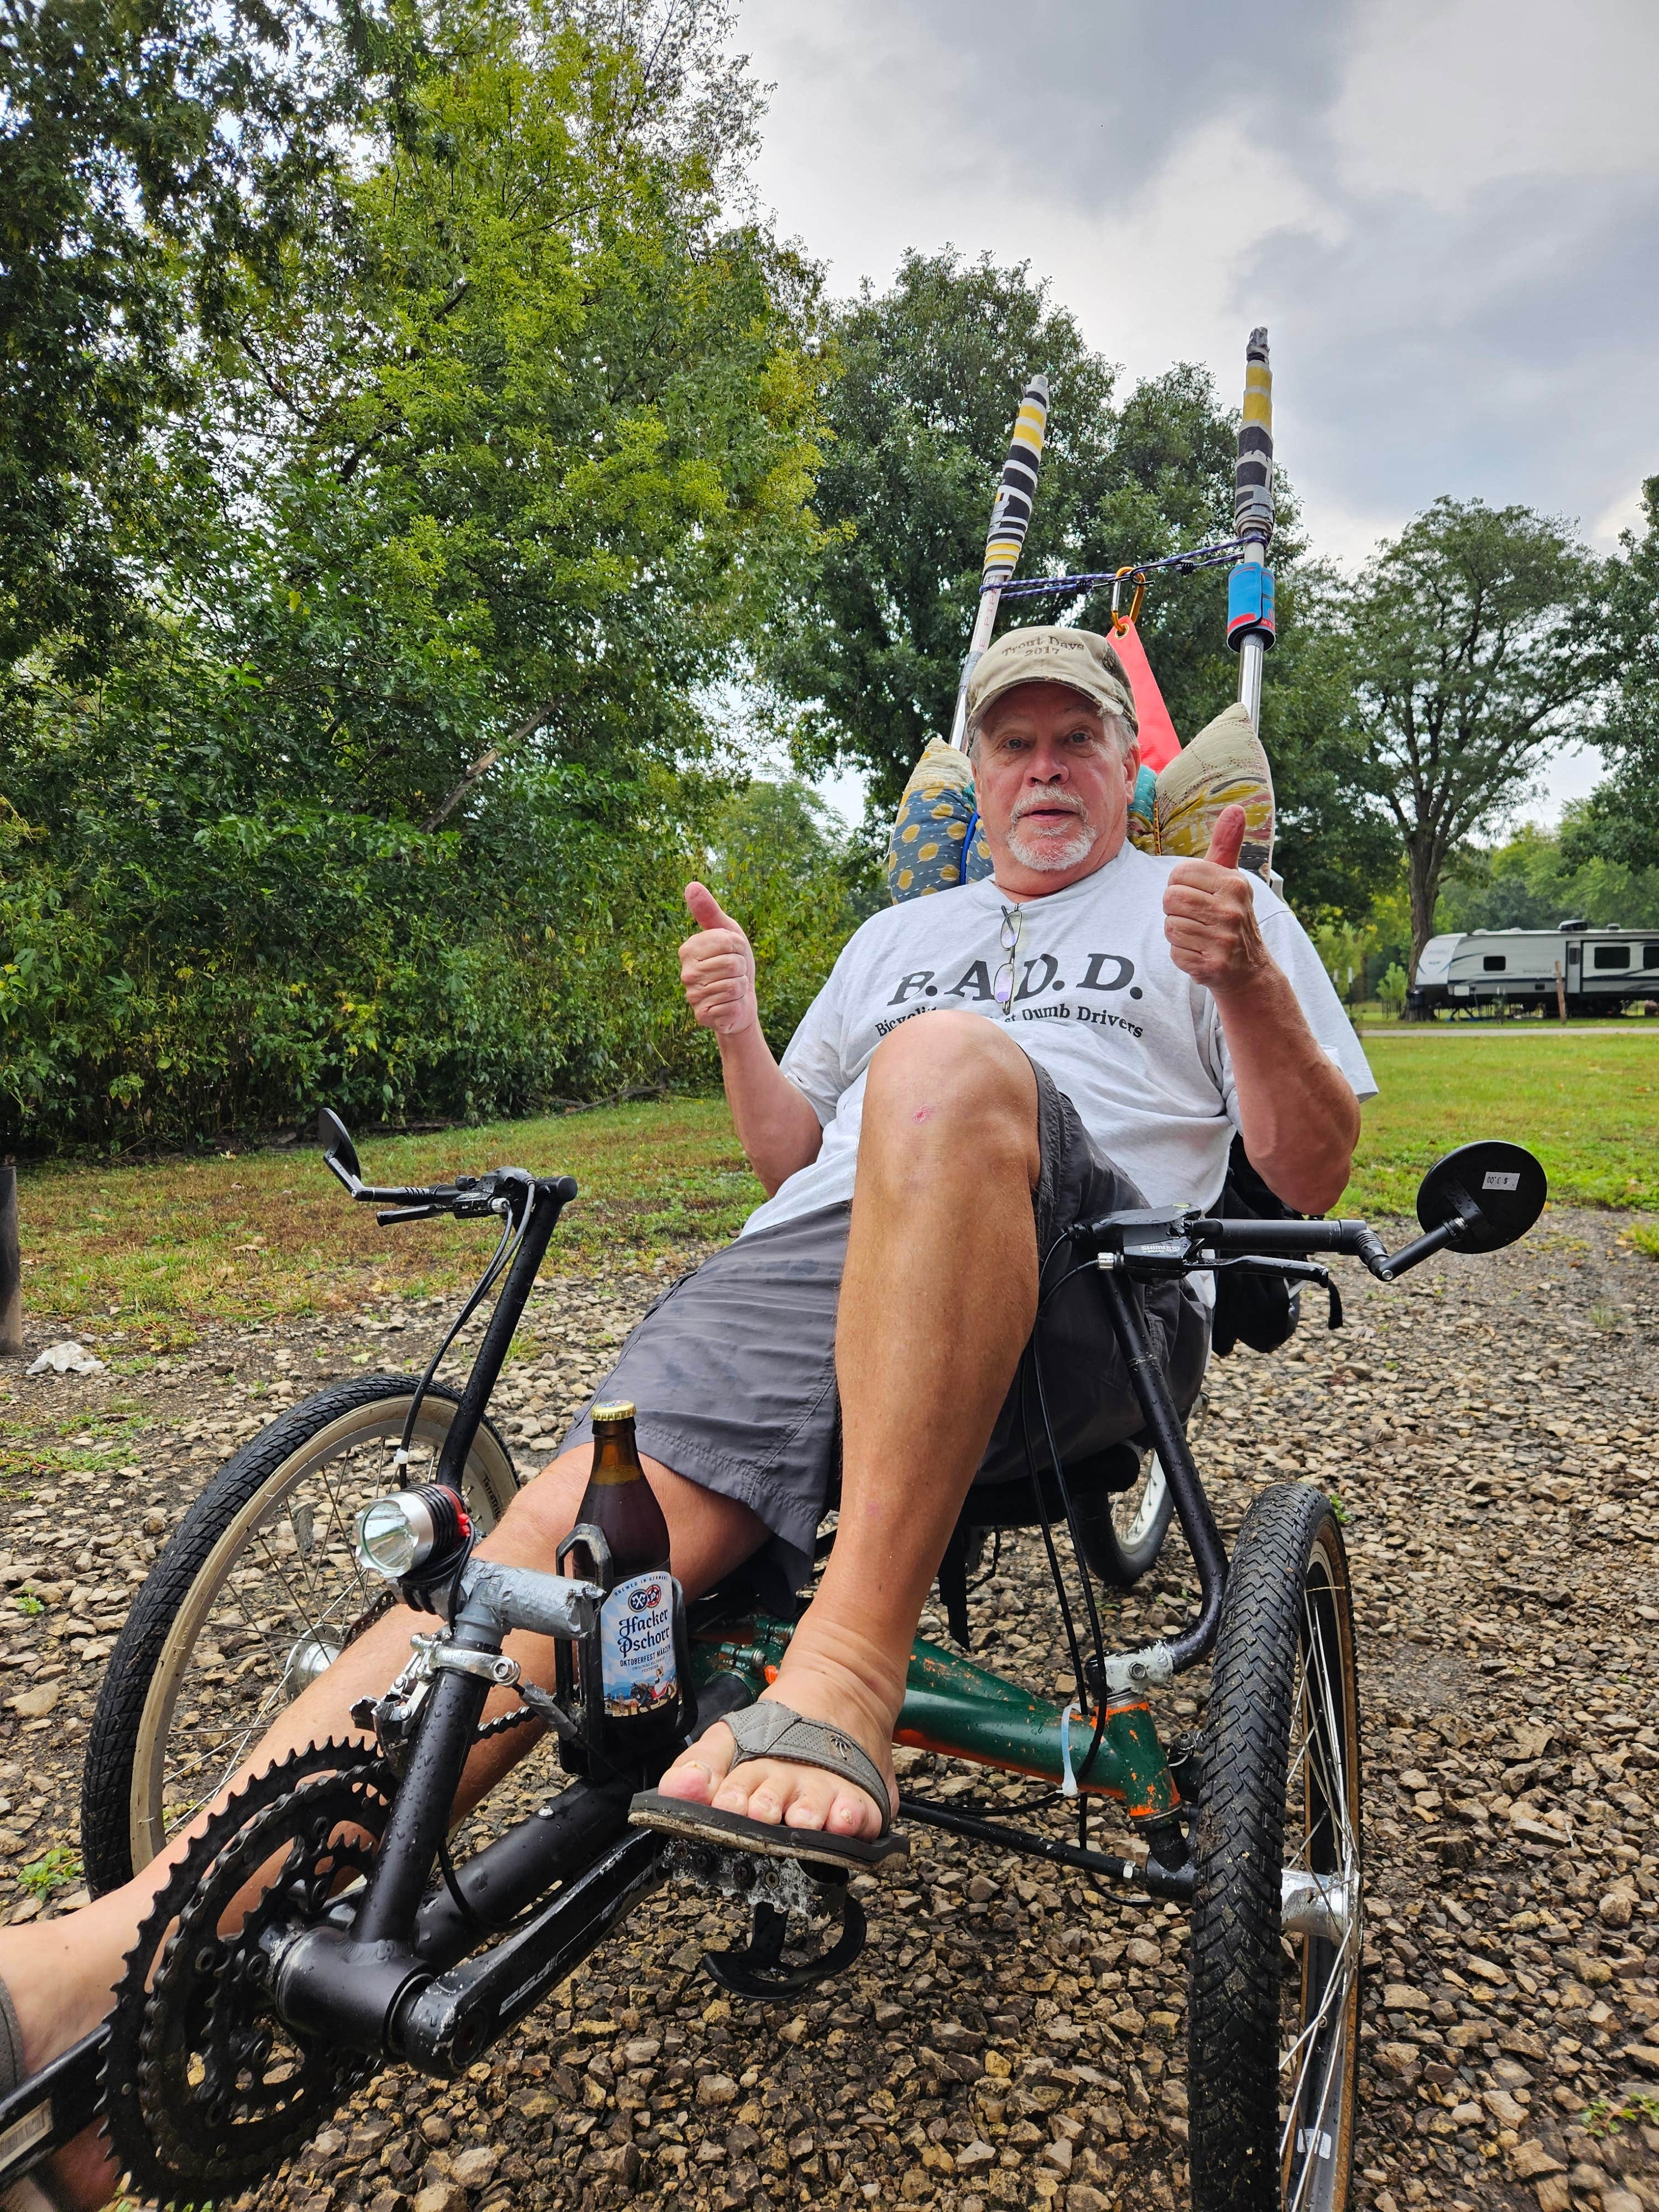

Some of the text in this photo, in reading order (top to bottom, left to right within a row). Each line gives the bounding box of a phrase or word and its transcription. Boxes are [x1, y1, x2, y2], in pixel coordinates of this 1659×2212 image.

[1001, 635, 1084, 656] Trout Days
[1024, 646, 1061, 657] 2017
[1022, 1003, 1071, 1021] Dumb
[1076, 1005, 1144, 1038] Drivers
[614, 1581, 638, 1597] BREWED
[619, 1608, 668, 1637] Hacker
[617, 1626, 670, 1659] Pschorr
[619, 1652, 655, 1667] OKTOBERFEST
